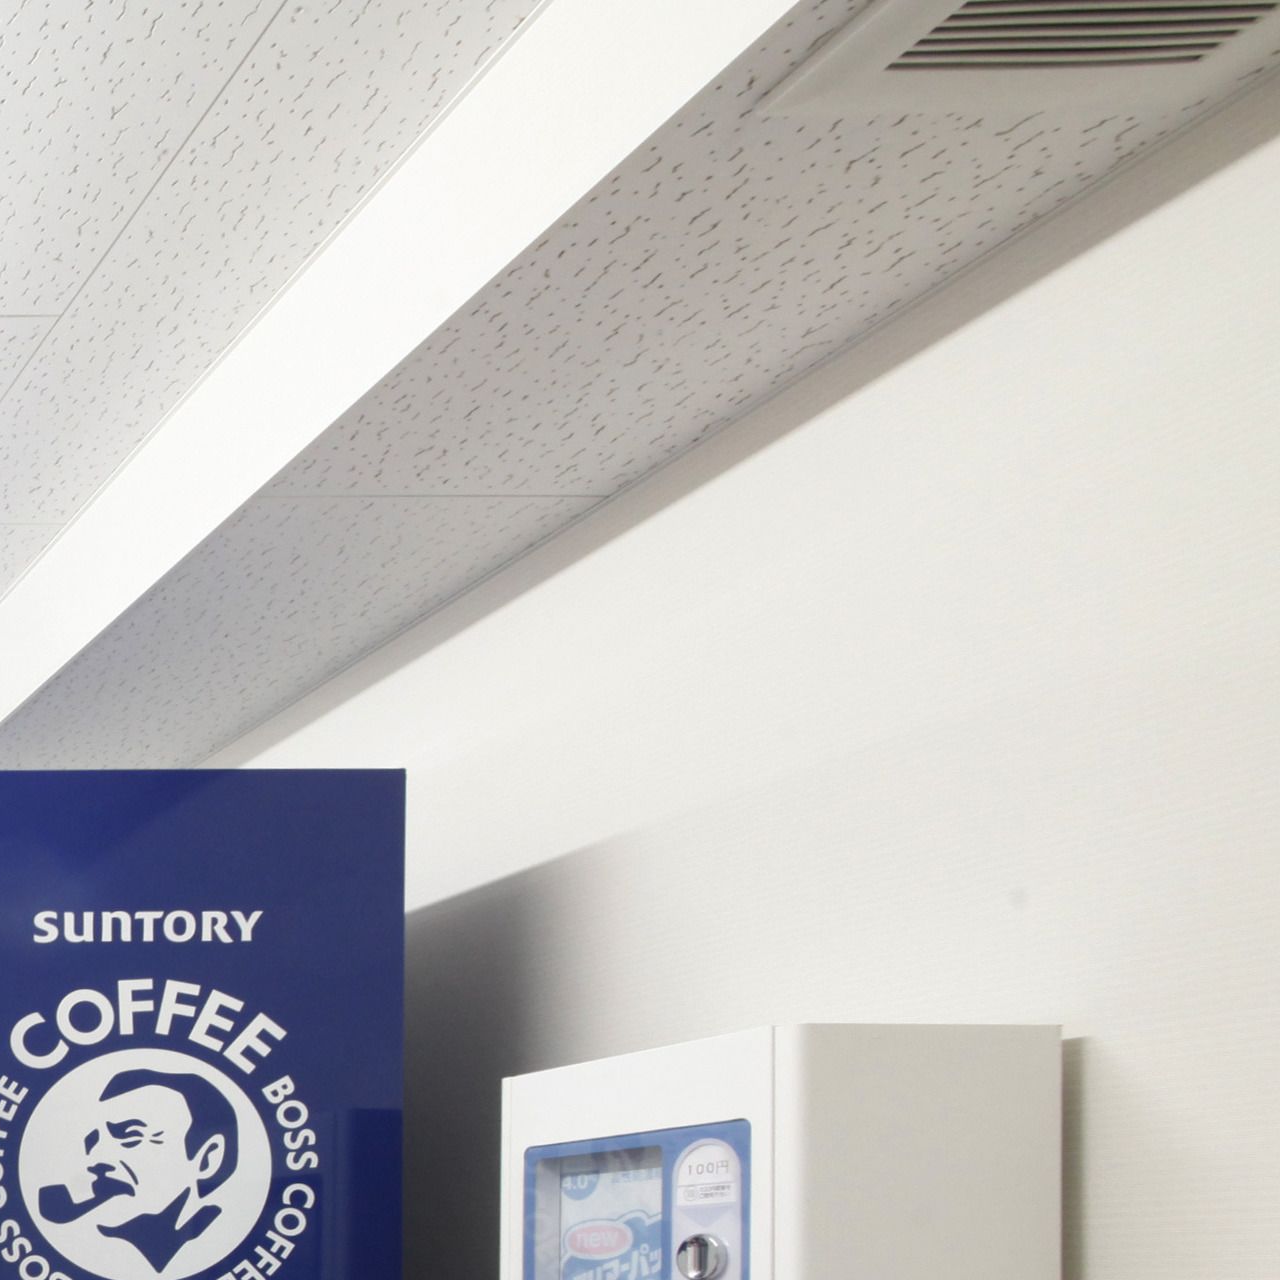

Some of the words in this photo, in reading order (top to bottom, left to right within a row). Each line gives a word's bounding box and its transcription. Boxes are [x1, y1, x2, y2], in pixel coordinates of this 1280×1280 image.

[32, 910, 264, 944] SUNTORY
[9, 978, 288, 1075] COFFEE
[261, 1074, 319, 1171] BOSS
[687, 1159, 729, 1176] 100円
[576, 1232, 620, 1250] new
